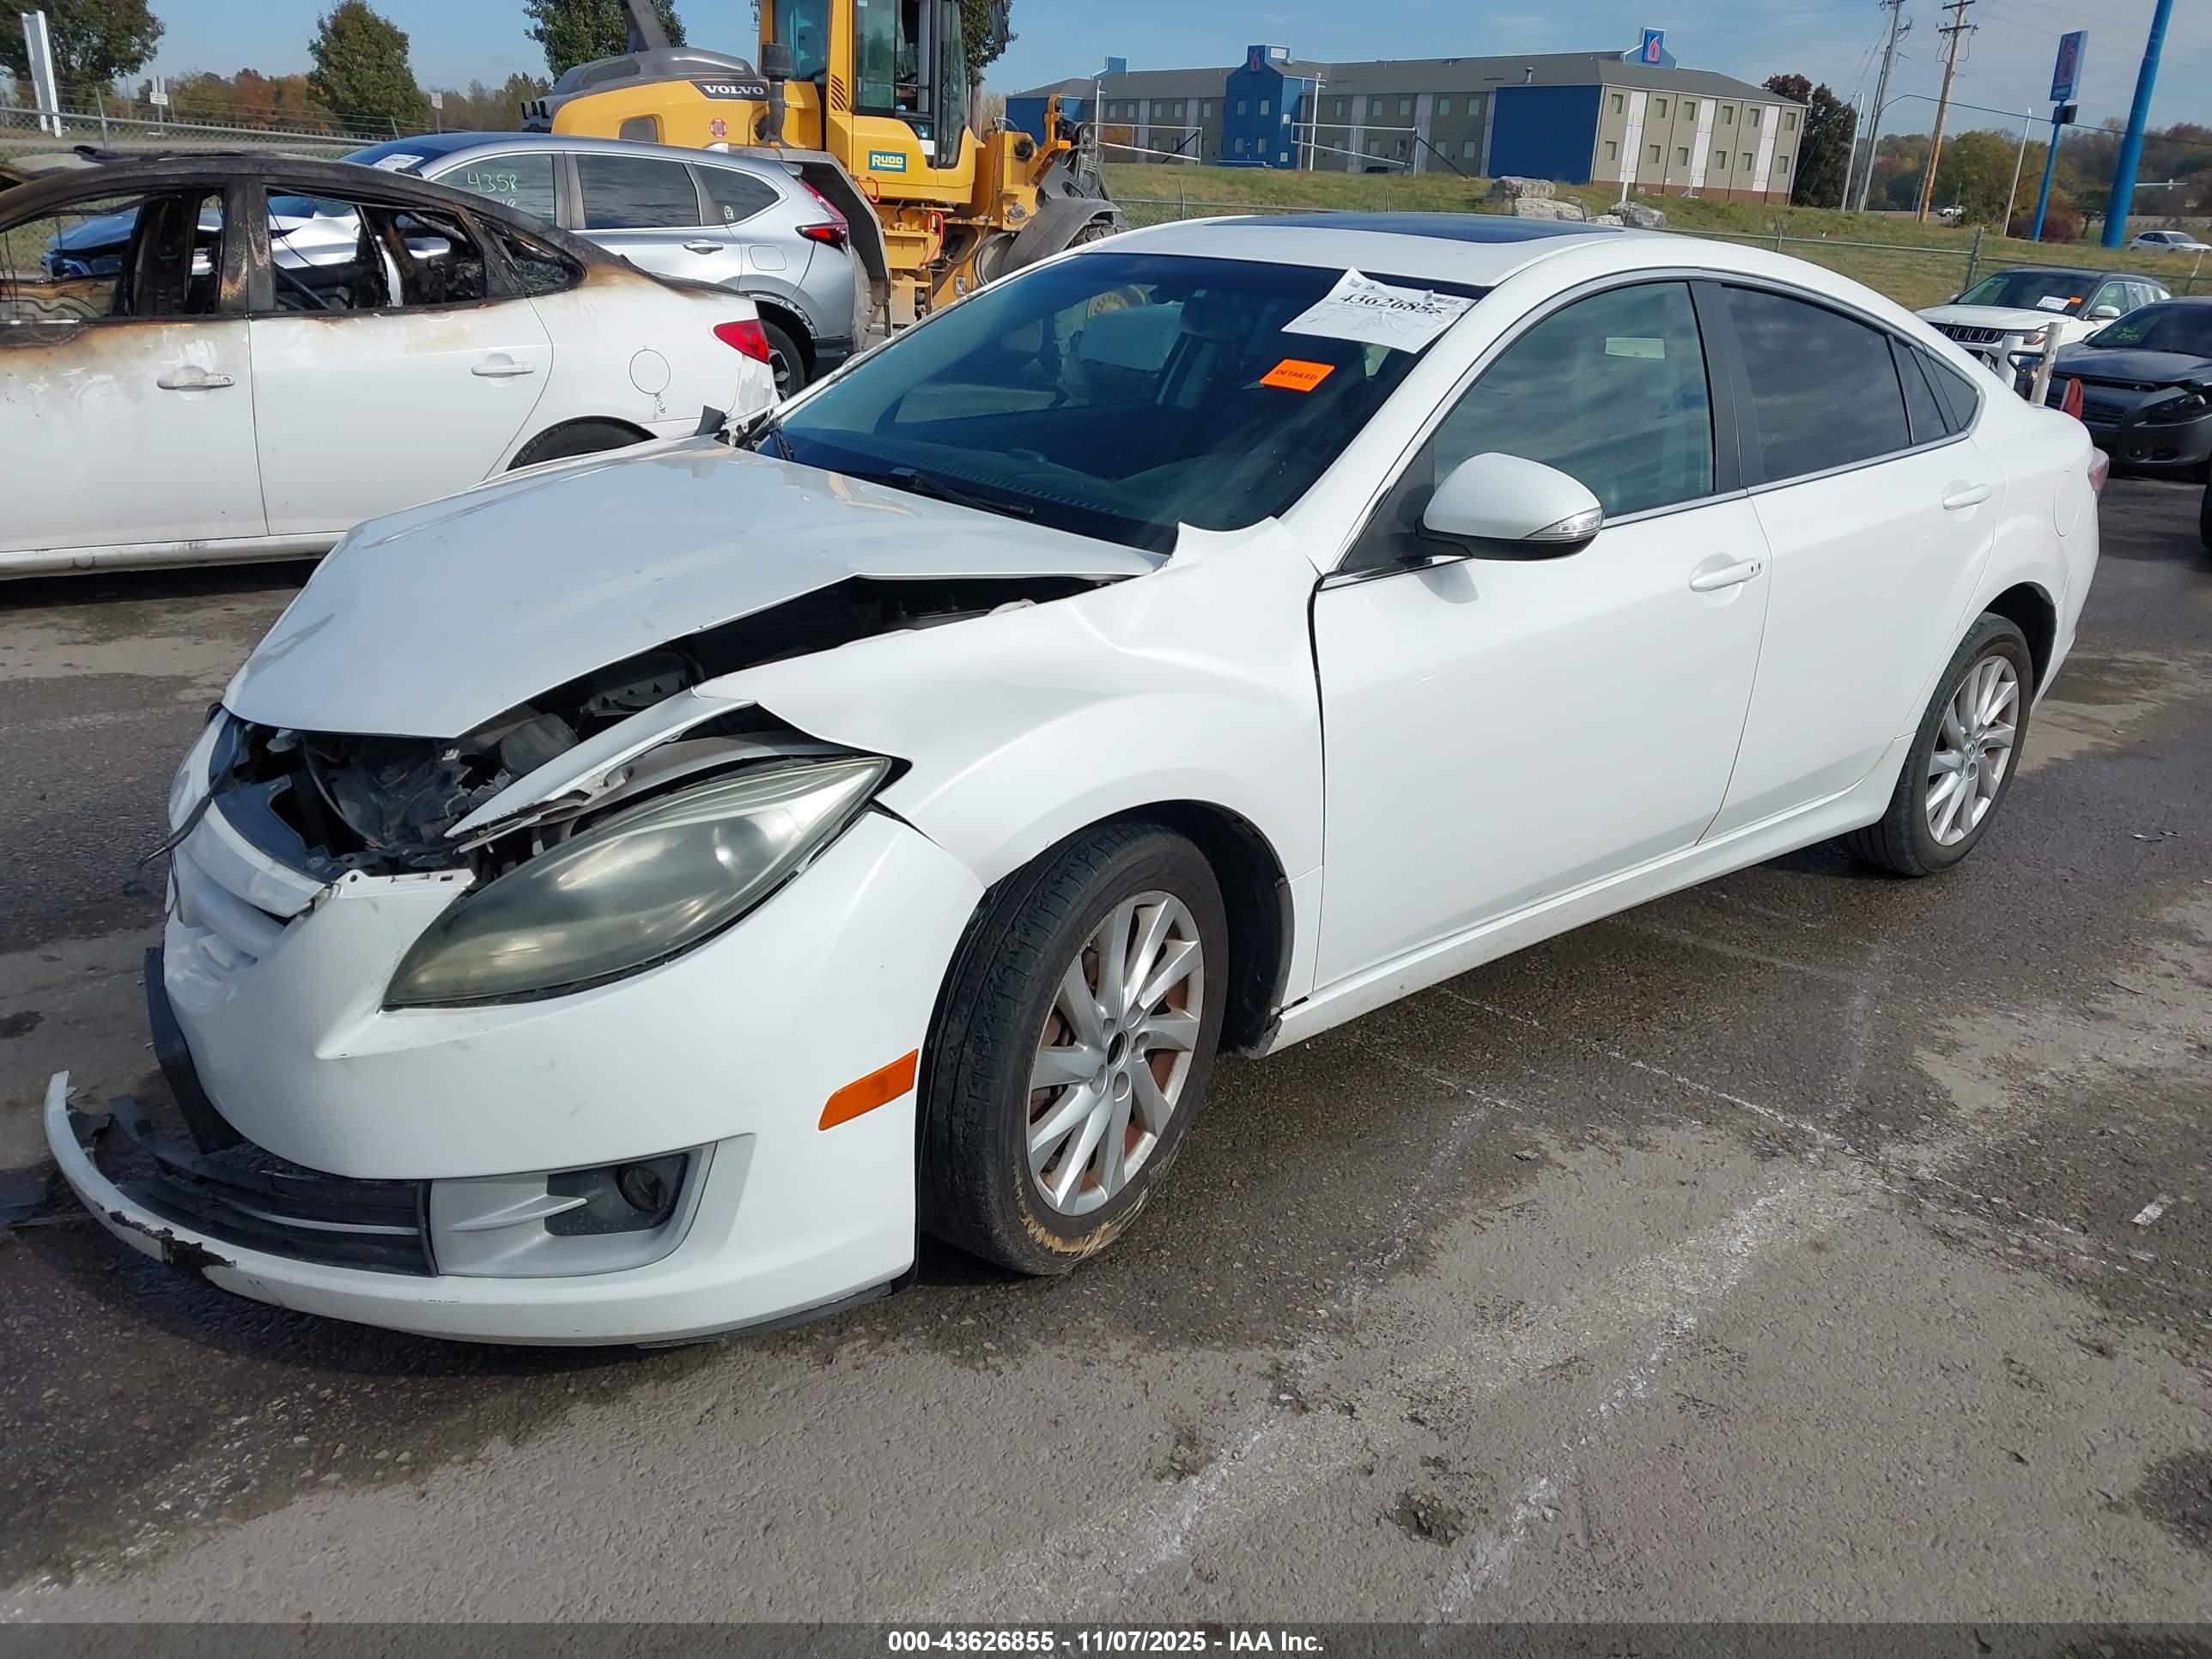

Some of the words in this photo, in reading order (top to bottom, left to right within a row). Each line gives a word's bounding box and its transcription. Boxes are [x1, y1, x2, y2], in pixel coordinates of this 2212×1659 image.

[1648, 35, 1660, 63] 6
[702, 85, 764, 94] VOLVO
[872, 155, 904, 167] RUDD
[467, 171, 519, 194] 4358
